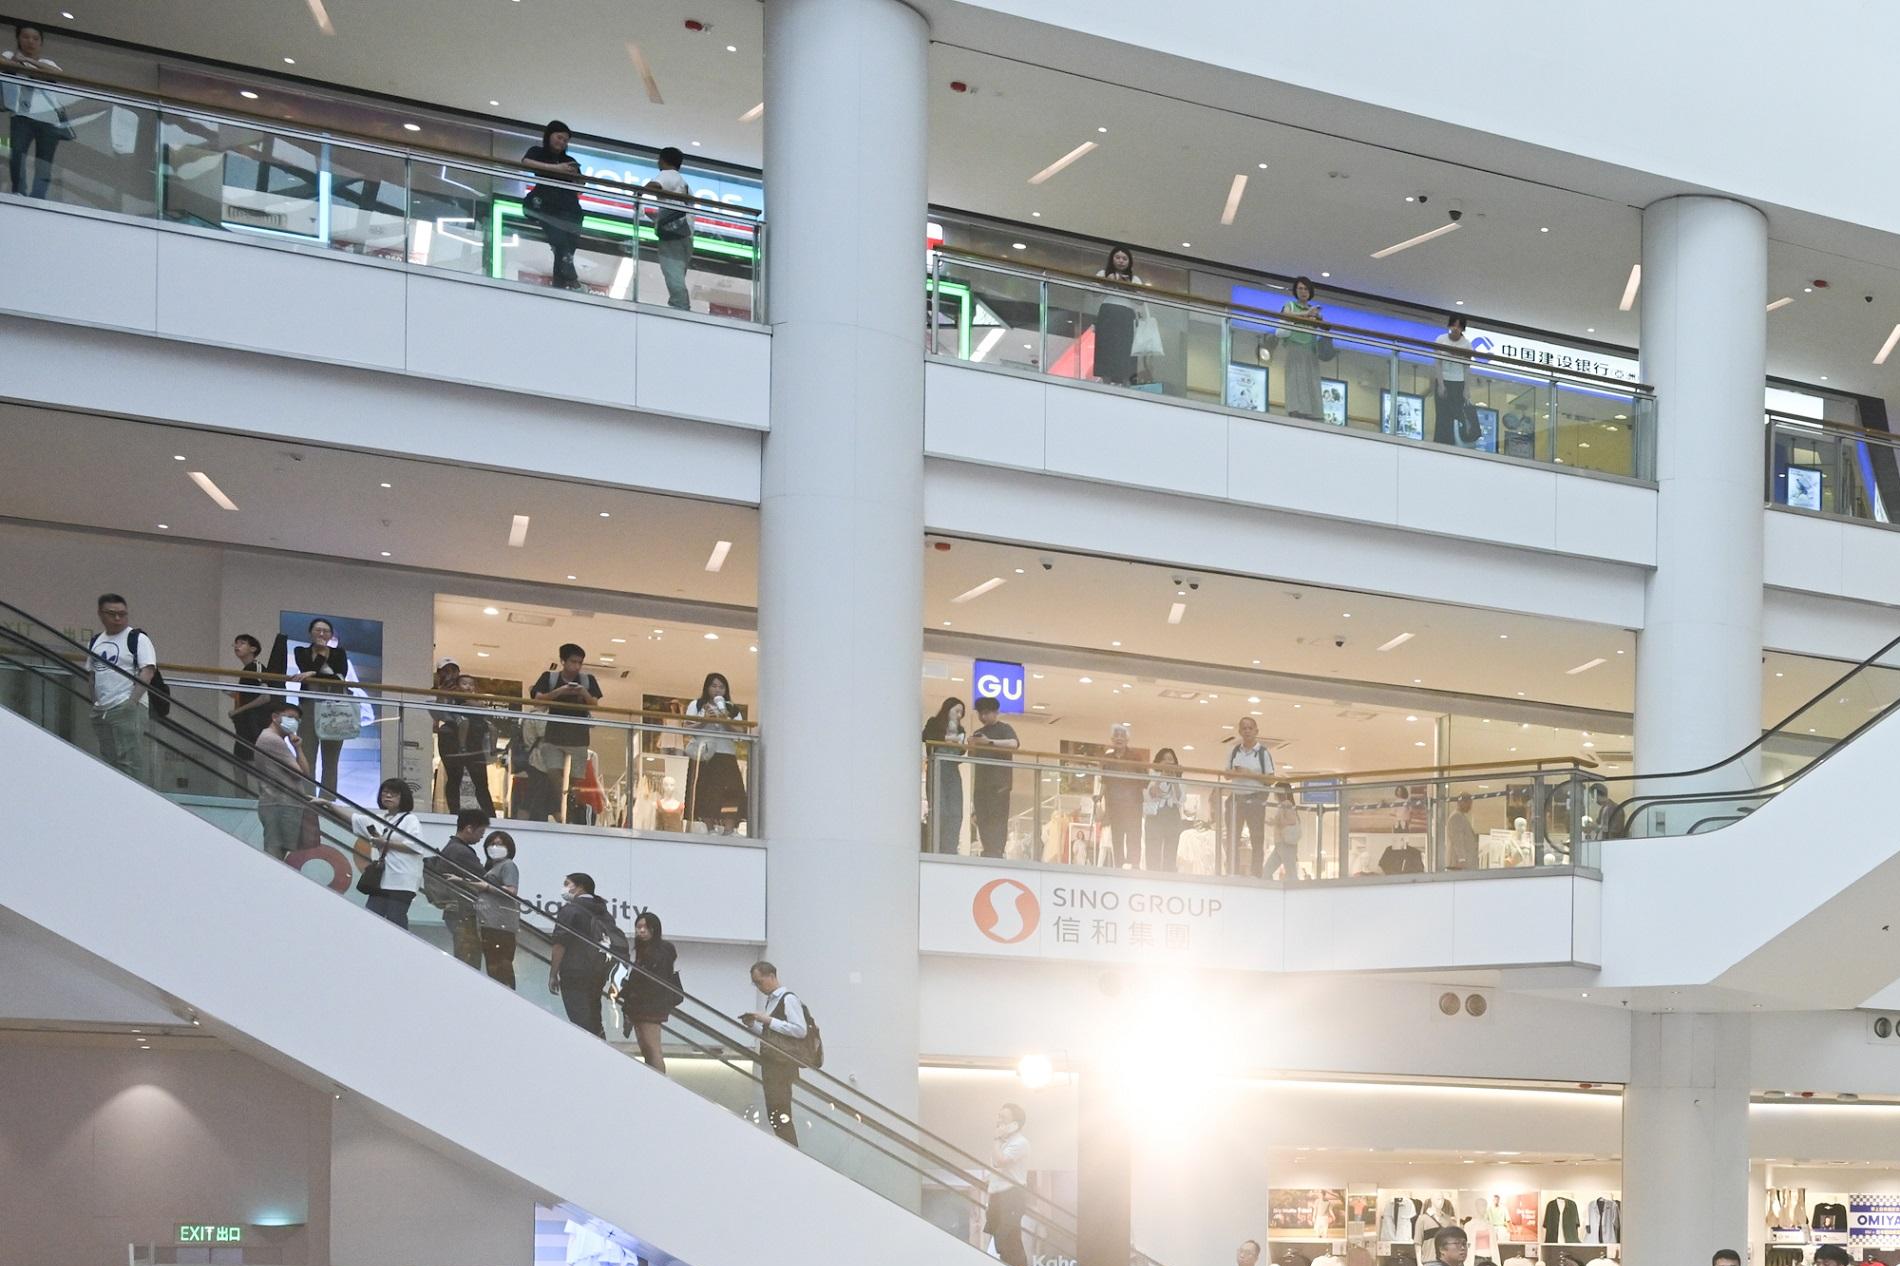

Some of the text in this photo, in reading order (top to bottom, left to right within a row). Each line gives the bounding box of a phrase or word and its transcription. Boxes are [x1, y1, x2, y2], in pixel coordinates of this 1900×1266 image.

[1502, 344, 1609, 377] 中国建设银行
[977, 675, 1022, 700] GU
[1052, 887, 1222, 918] SINO GROUP
[1052, 915, 1190, 948] 信和集團
[180, 1226, 241, 1241] EXIT 出口
